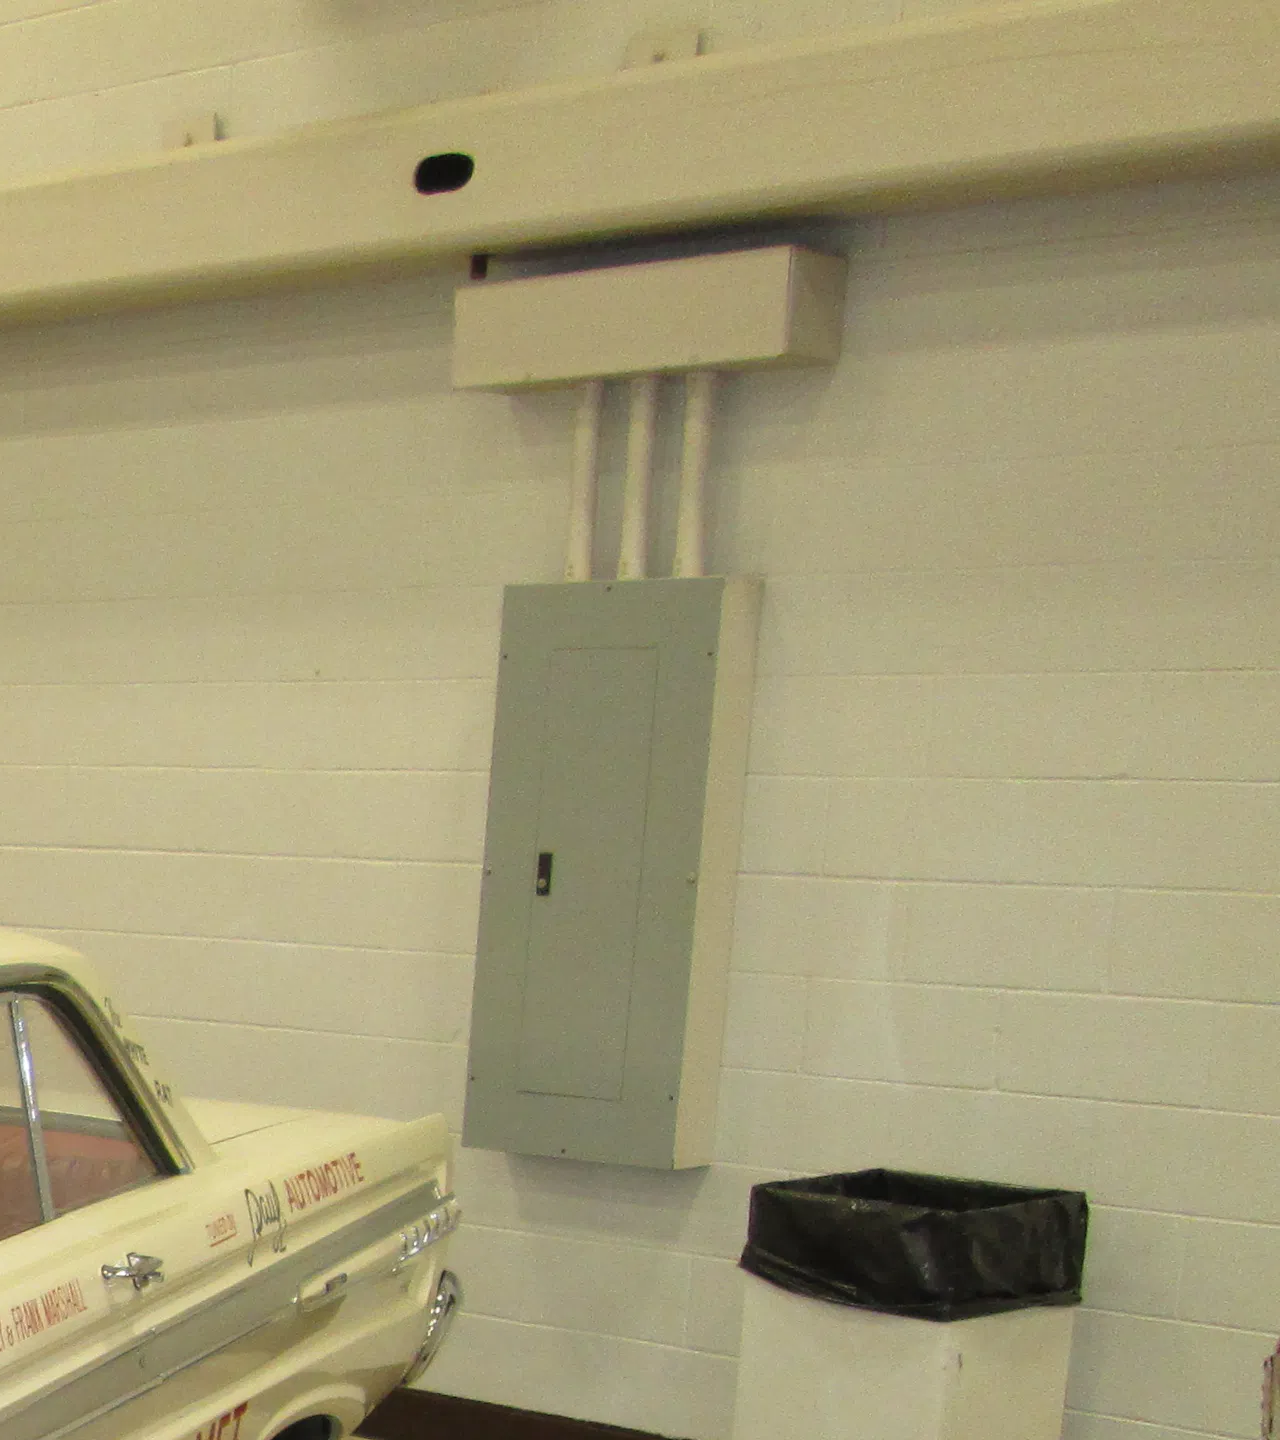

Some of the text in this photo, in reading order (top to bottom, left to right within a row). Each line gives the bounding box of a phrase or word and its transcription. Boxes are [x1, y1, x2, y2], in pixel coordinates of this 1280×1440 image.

[283, 1152, 364, 1212] AUTOMOTIVE
[10, 1299, 44, 1342] FRANK
[40, 1278, 88, 1329] MARSHALL
